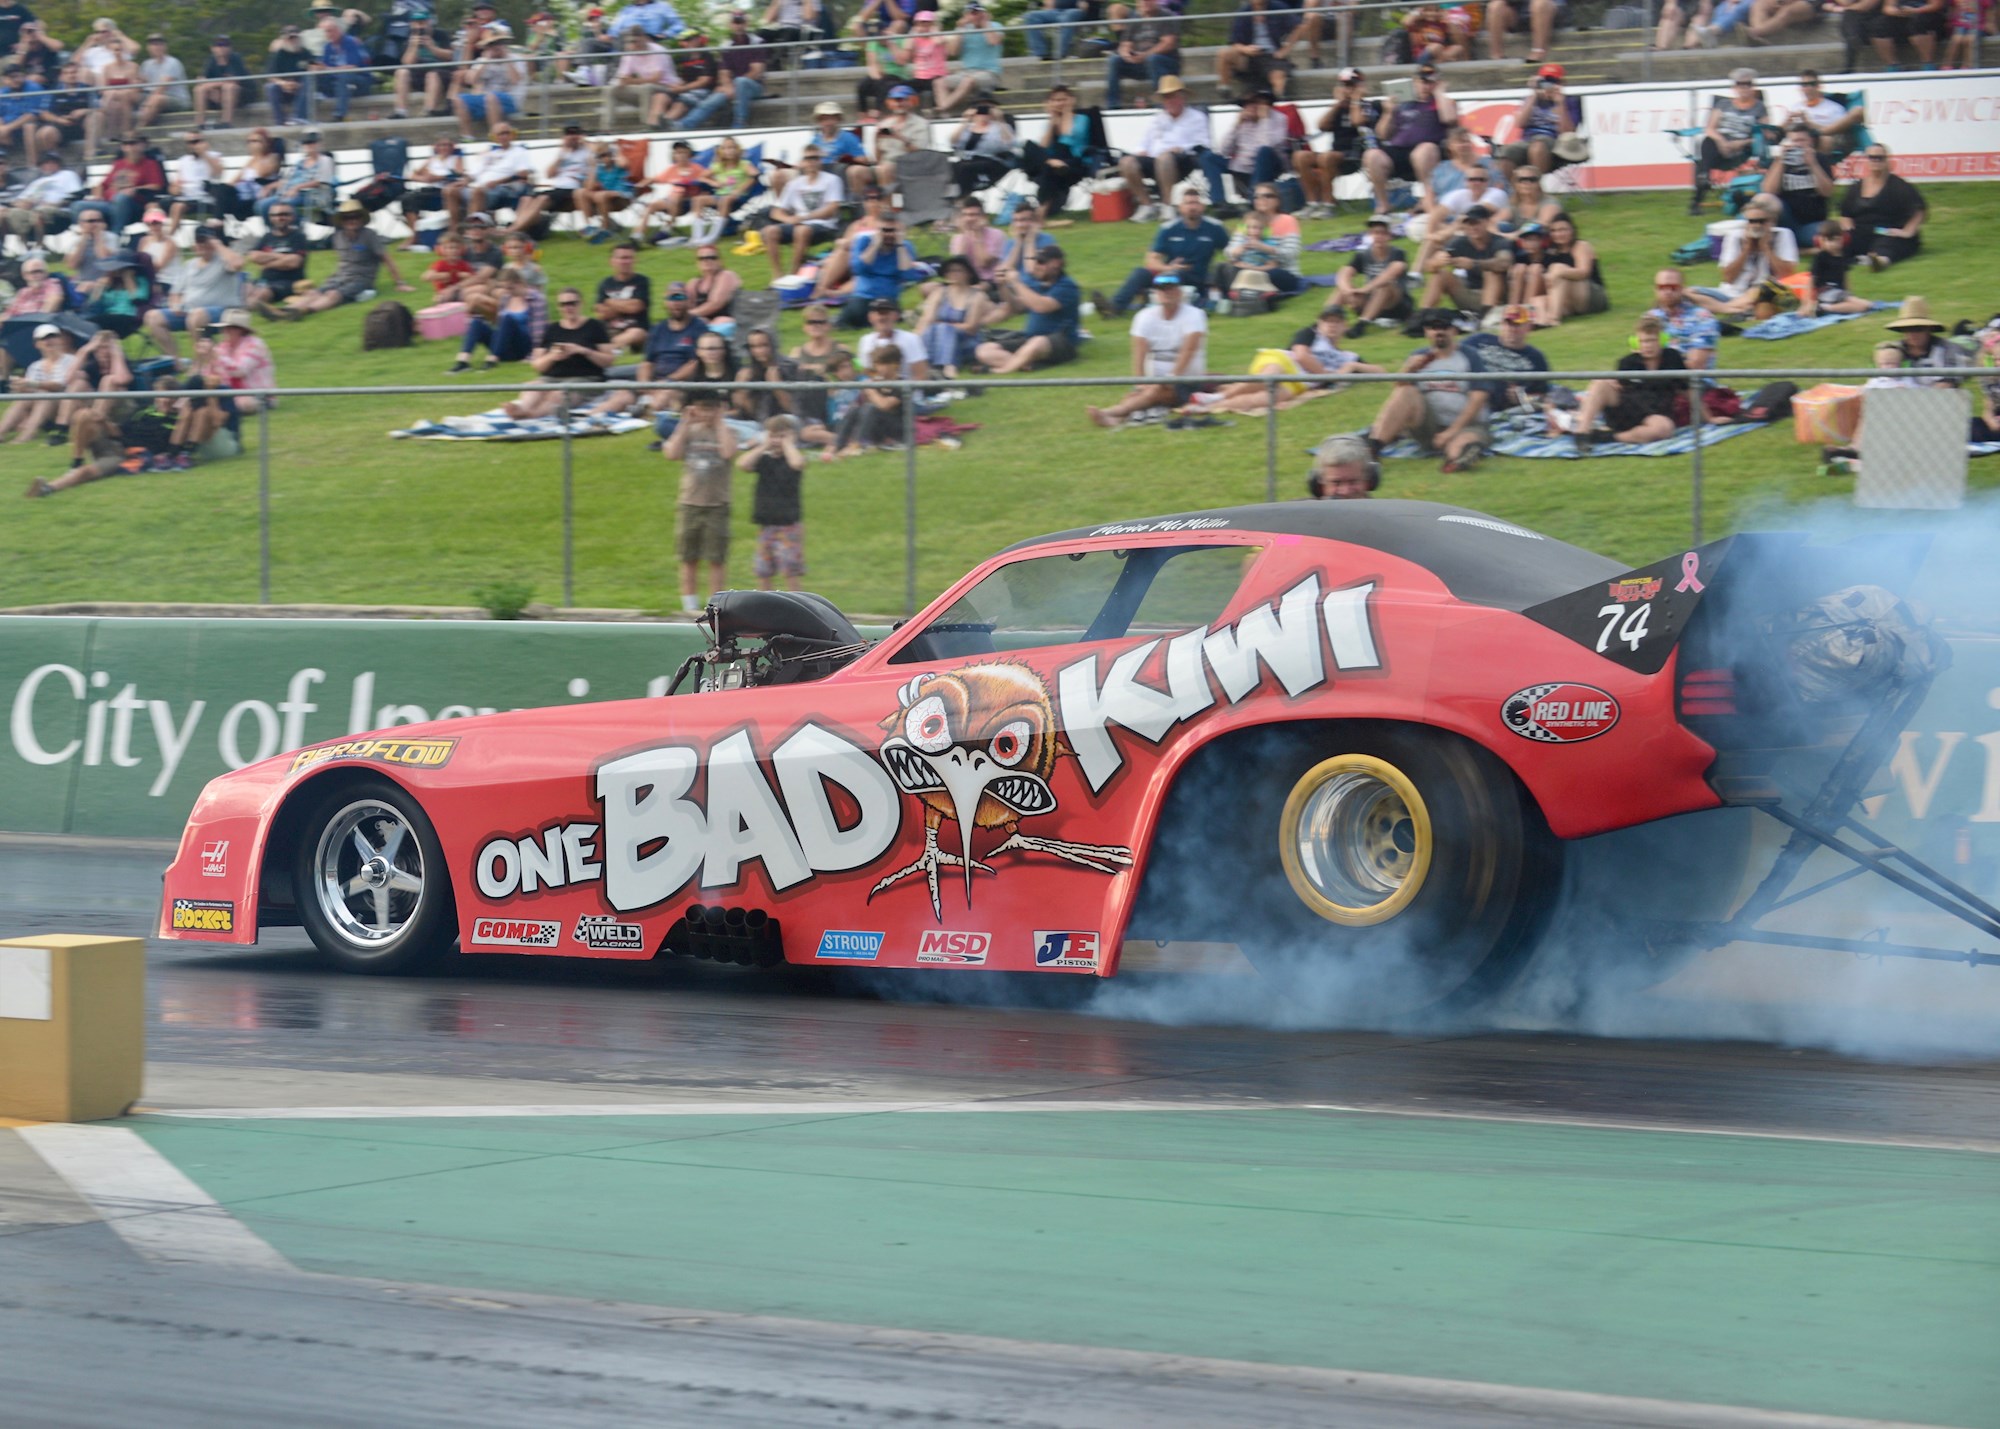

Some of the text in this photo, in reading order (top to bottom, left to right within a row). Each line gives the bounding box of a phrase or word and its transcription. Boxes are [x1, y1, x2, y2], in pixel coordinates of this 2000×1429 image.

[1596, 603, 1651, 653] 74
[1058, 572, 1381, 794] KIWI
[1535, 702, 1611, 720] RED LINE
[10, 664, 206, 796] City
[218, 668, 326, 770] of
[290, 740, 453, 774] AEROFLOW
[596, 722, 900, 911] BAD
[204, 864, 226, 872] HAAS
[476, 823, 602, 898] ONE
[478, 921, 540, 938] COMP
[589, 925, 640, 940] WELD
[824, 934, 878, 951] STROUD
[921, 933, 987, 954] MSD
[1037, 933, 1095, 963] JE
